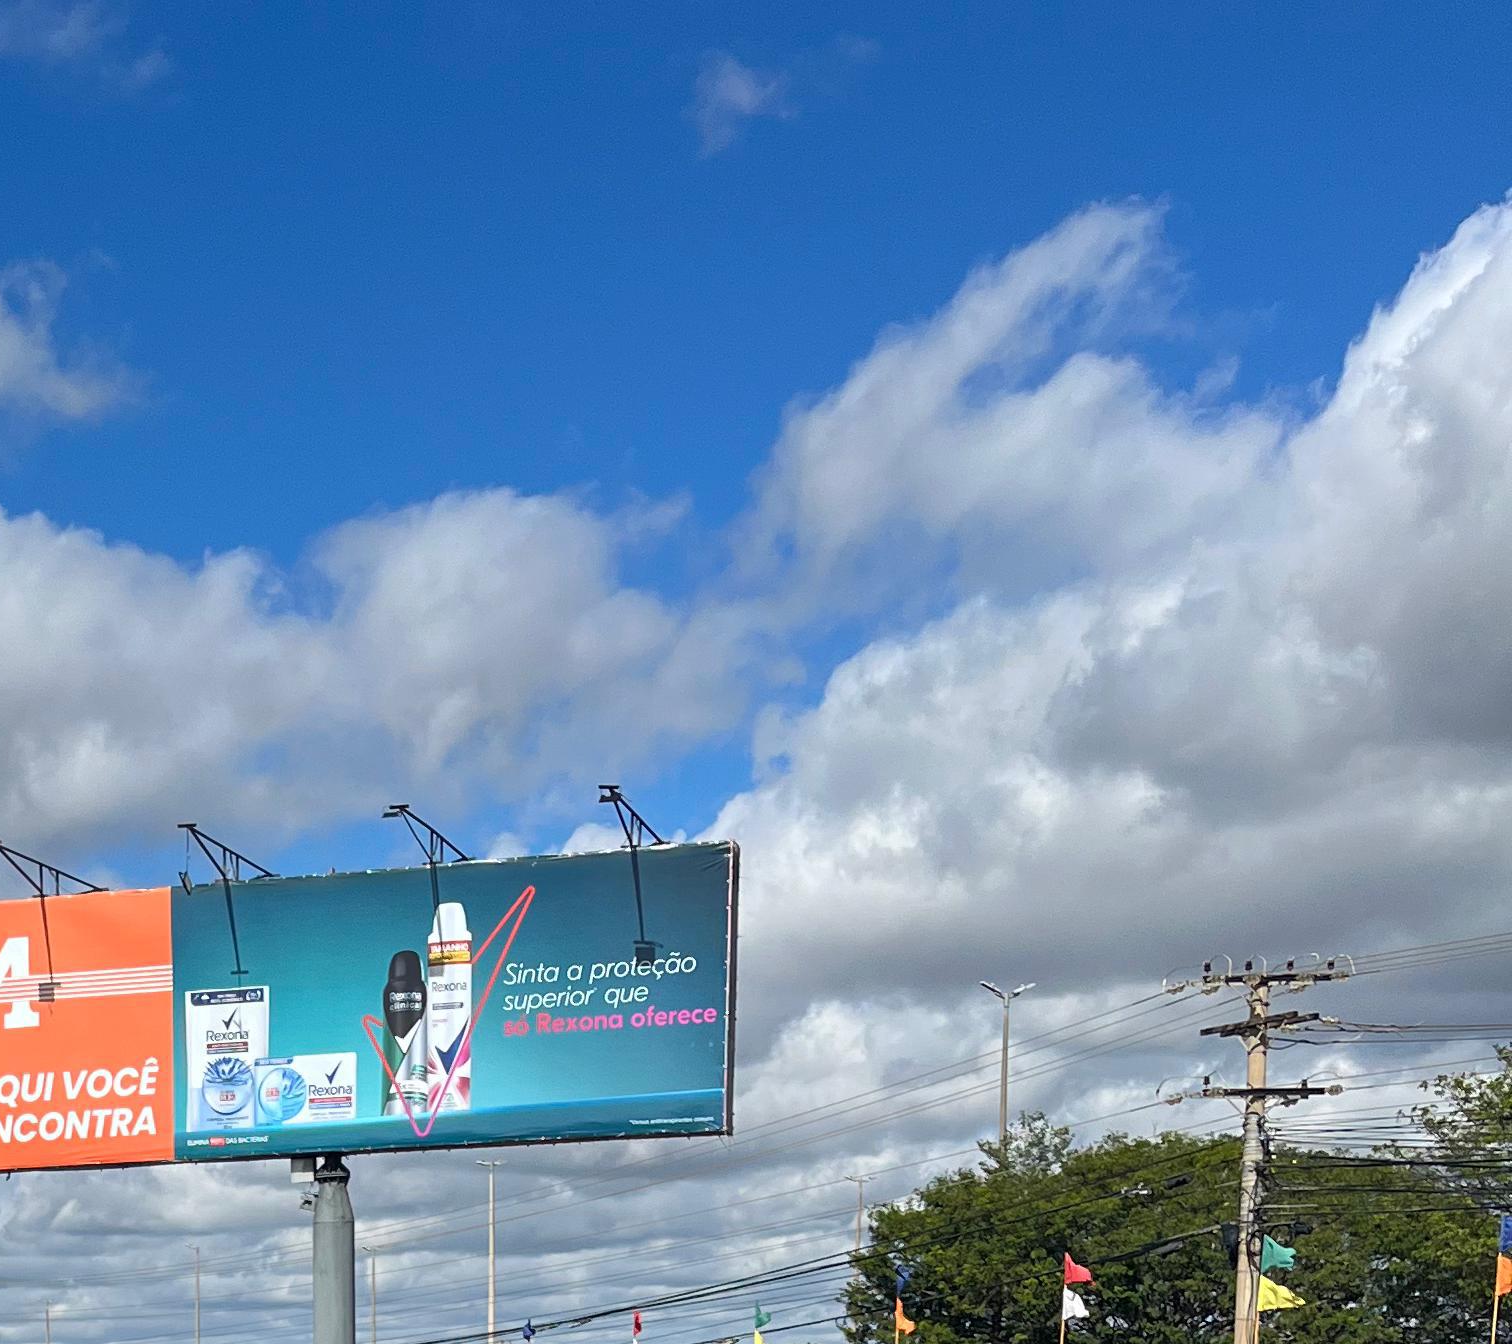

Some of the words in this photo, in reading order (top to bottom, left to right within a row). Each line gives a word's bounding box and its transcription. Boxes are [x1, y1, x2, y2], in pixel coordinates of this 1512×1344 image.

[503, 962, 560, 985] Sinta
[567, 963, 583, 981] a
[589, 951, 697, 984] proteção
[389, 991, 423, 1003] Rexona
[431, 981, 468, 993] Rexona
[502, 986, 595, 1014] superior
[604, 985, 649, 1008] que
[503, 1013, 530, 1037] só
[536, 1012, 624, 1036] Rexona
[630, 1004, 718, 1029] oferece
[205, 1030, 250, 1042] Rexona
[63, 1056, 160, 1100] VOCÊ
[308, 1084, 354, 1097] Rexona
